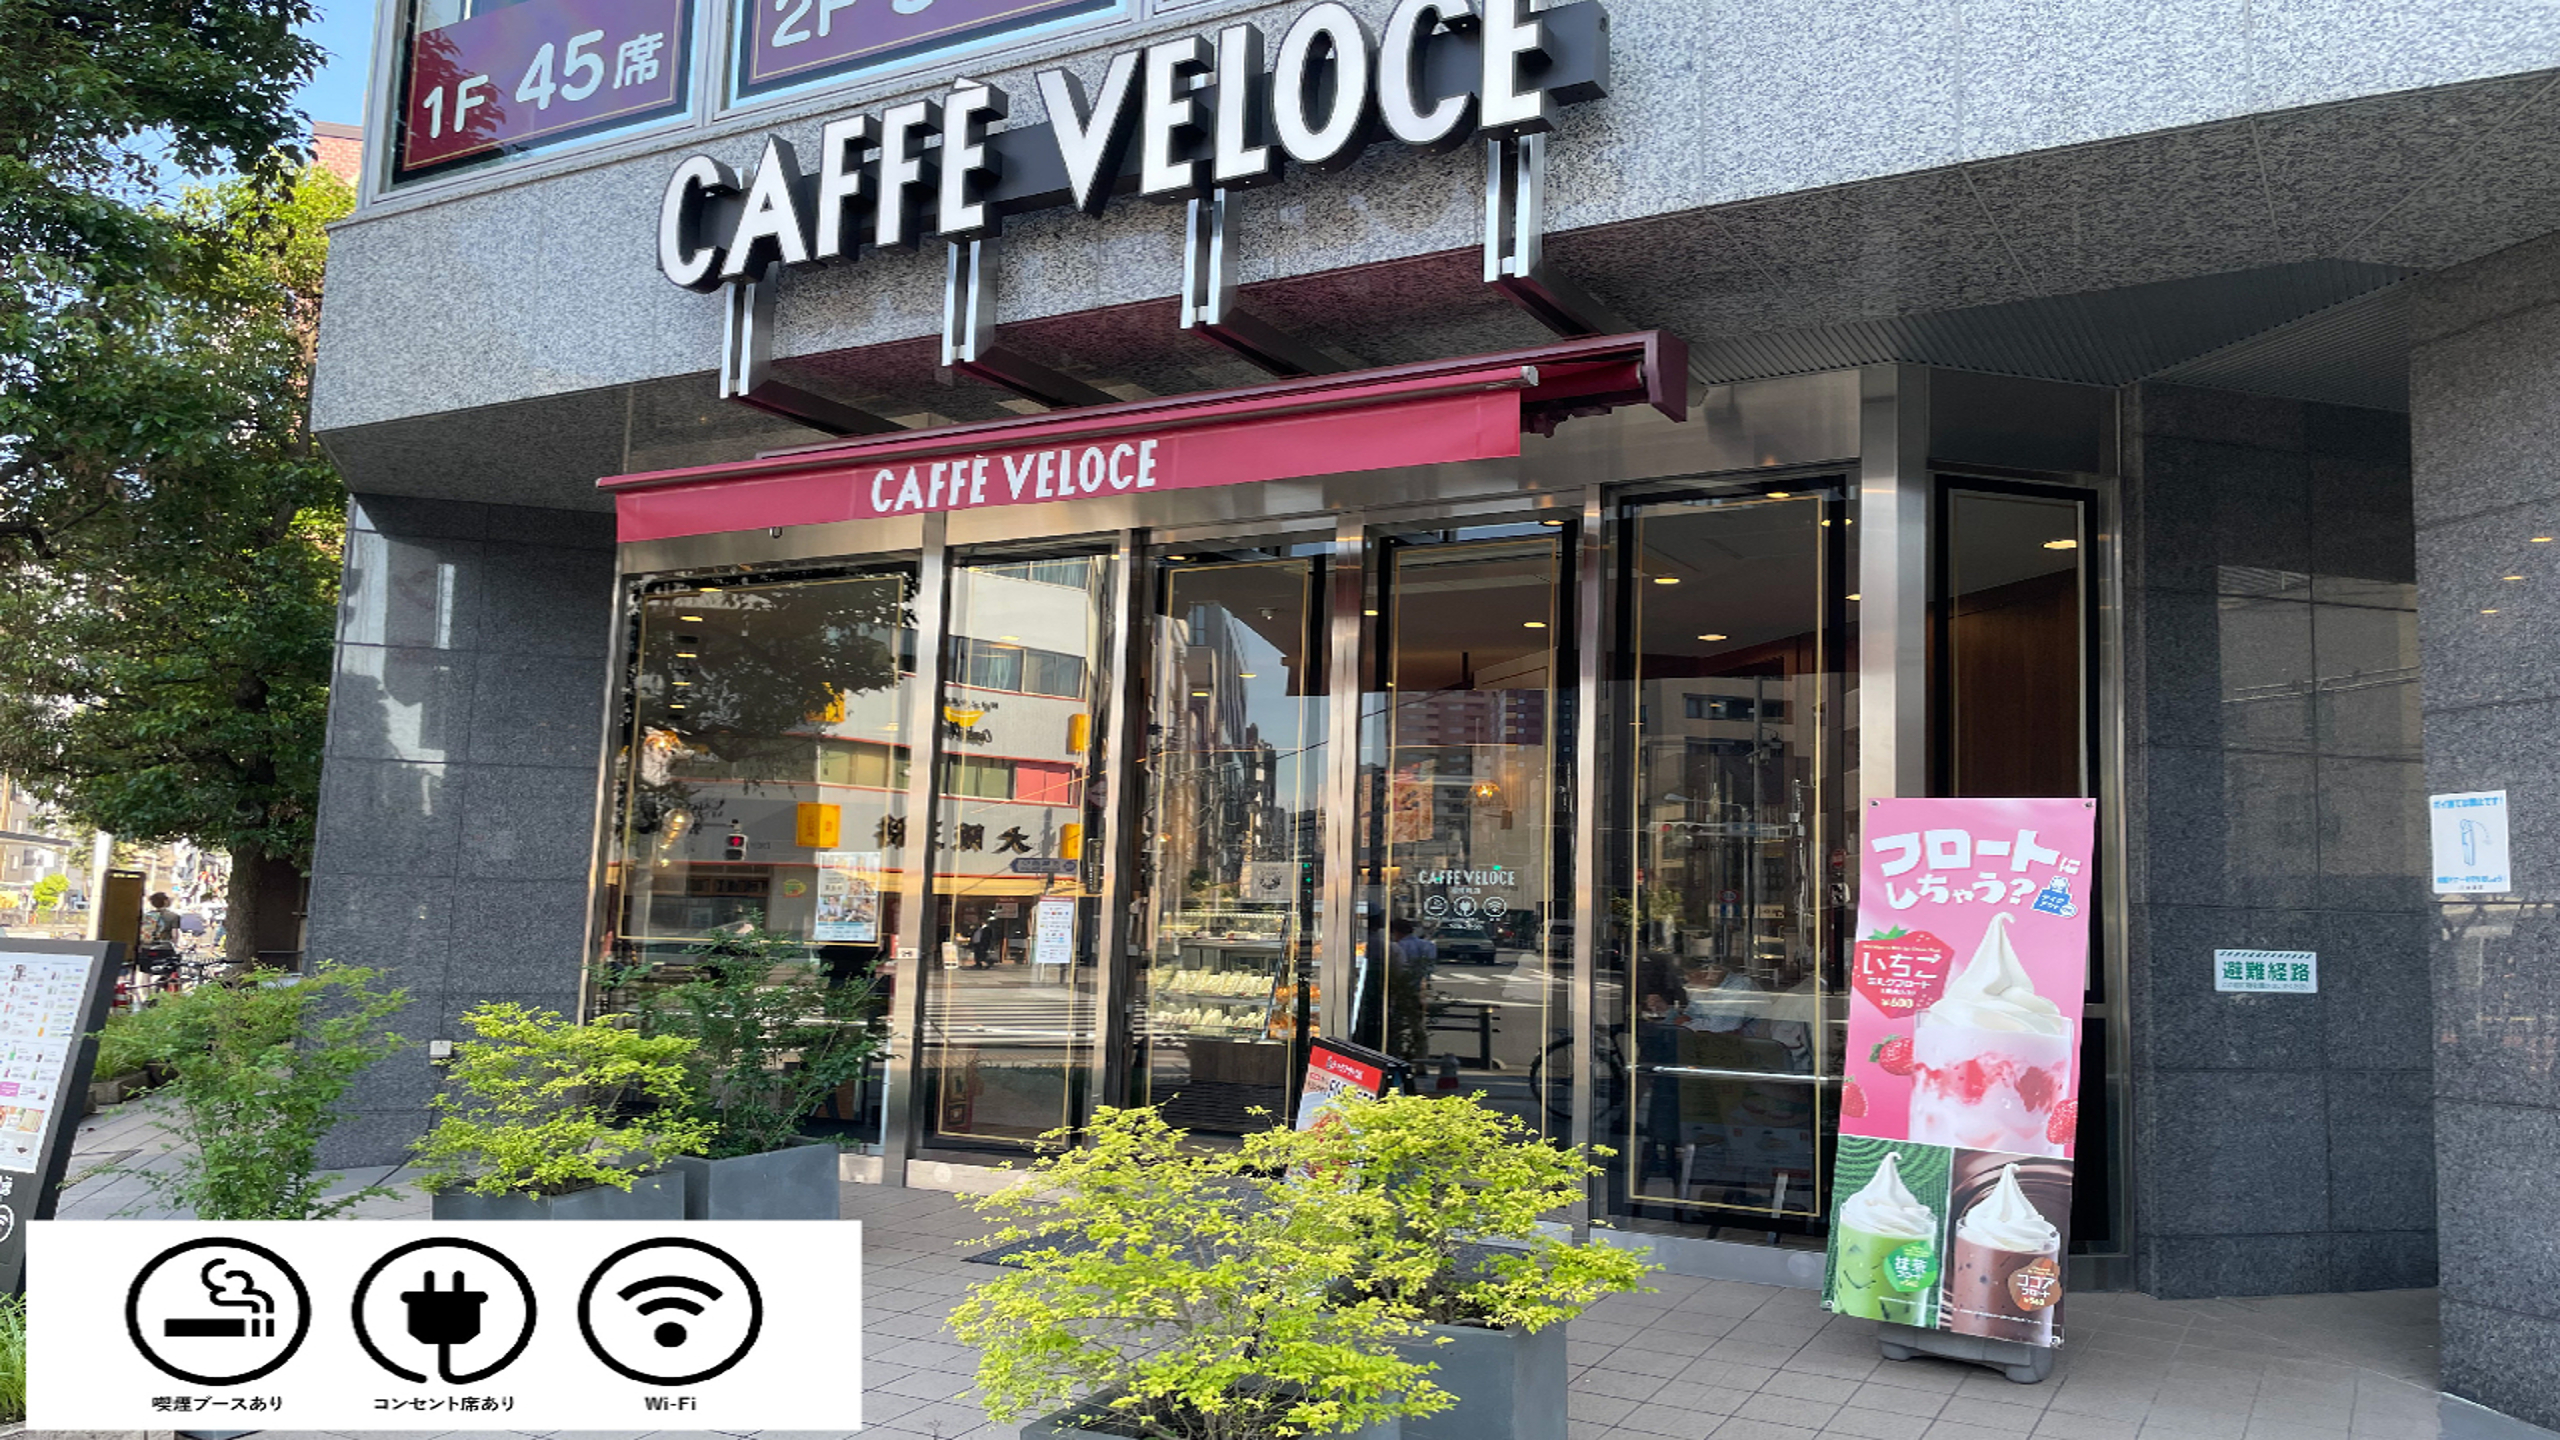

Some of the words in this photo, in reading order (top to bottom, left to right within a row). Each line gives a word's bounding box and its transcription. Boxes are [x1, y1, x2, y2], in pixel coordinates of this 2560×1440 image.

[423, 74, 489, 139] 1F
[515, 29, 664, 111] 45席
[658, 75, 993, 291] CAFFÈ
[1034, 0, 1549, 213] VELOCE
[871, 455, 990, 514] CAFFÈ
[1002, 439, 1159, 501] VELOCE
[1871, 828, 2081, 877] フロートに
[1463, 870, 1515, 886] VELOCE
[1885, 871, 2037, 910] しちゃう?
[1863, 952, 1943, 979] いちご
[2222, 961, 2310, 982] 避難経路
[2016, 1274, 2057, 1290] ココア
